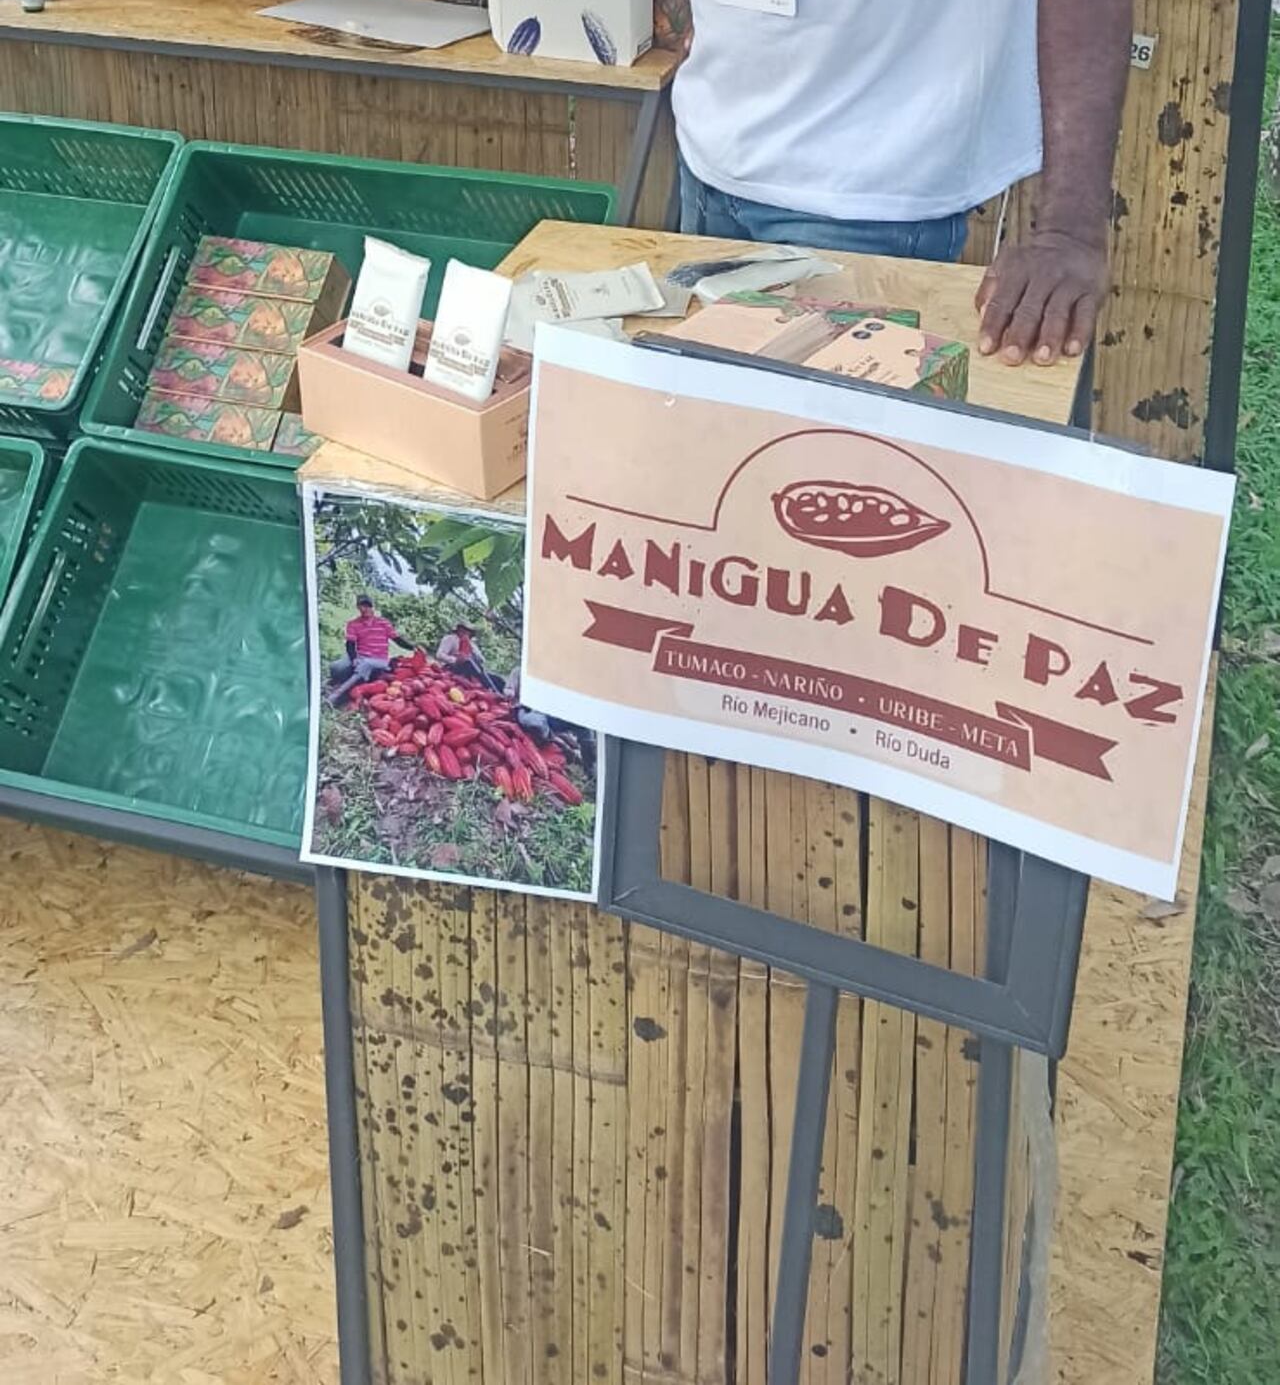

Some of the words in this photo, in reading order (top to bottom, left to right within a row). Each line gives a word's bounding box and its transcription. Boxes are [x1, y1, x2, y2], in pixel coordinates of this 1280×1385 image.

[541, 513, 857, 626] MANIGUA
[878, 584, 999, 667] DE
[1022, 632, 1184, 725] PAZ
[663, 648, 747, 681] TUMACO
[762, 668, 845, 702] NARIÑO
[878, 695, 944, 733] URIBE
[960, 721, 1019, 759] META
[720, 693, 748, 715] Río
[752, 699, 831, 732] Mejicano
[875, 729, 902, 753] Río
[906, 739, 951, 770] Duda
